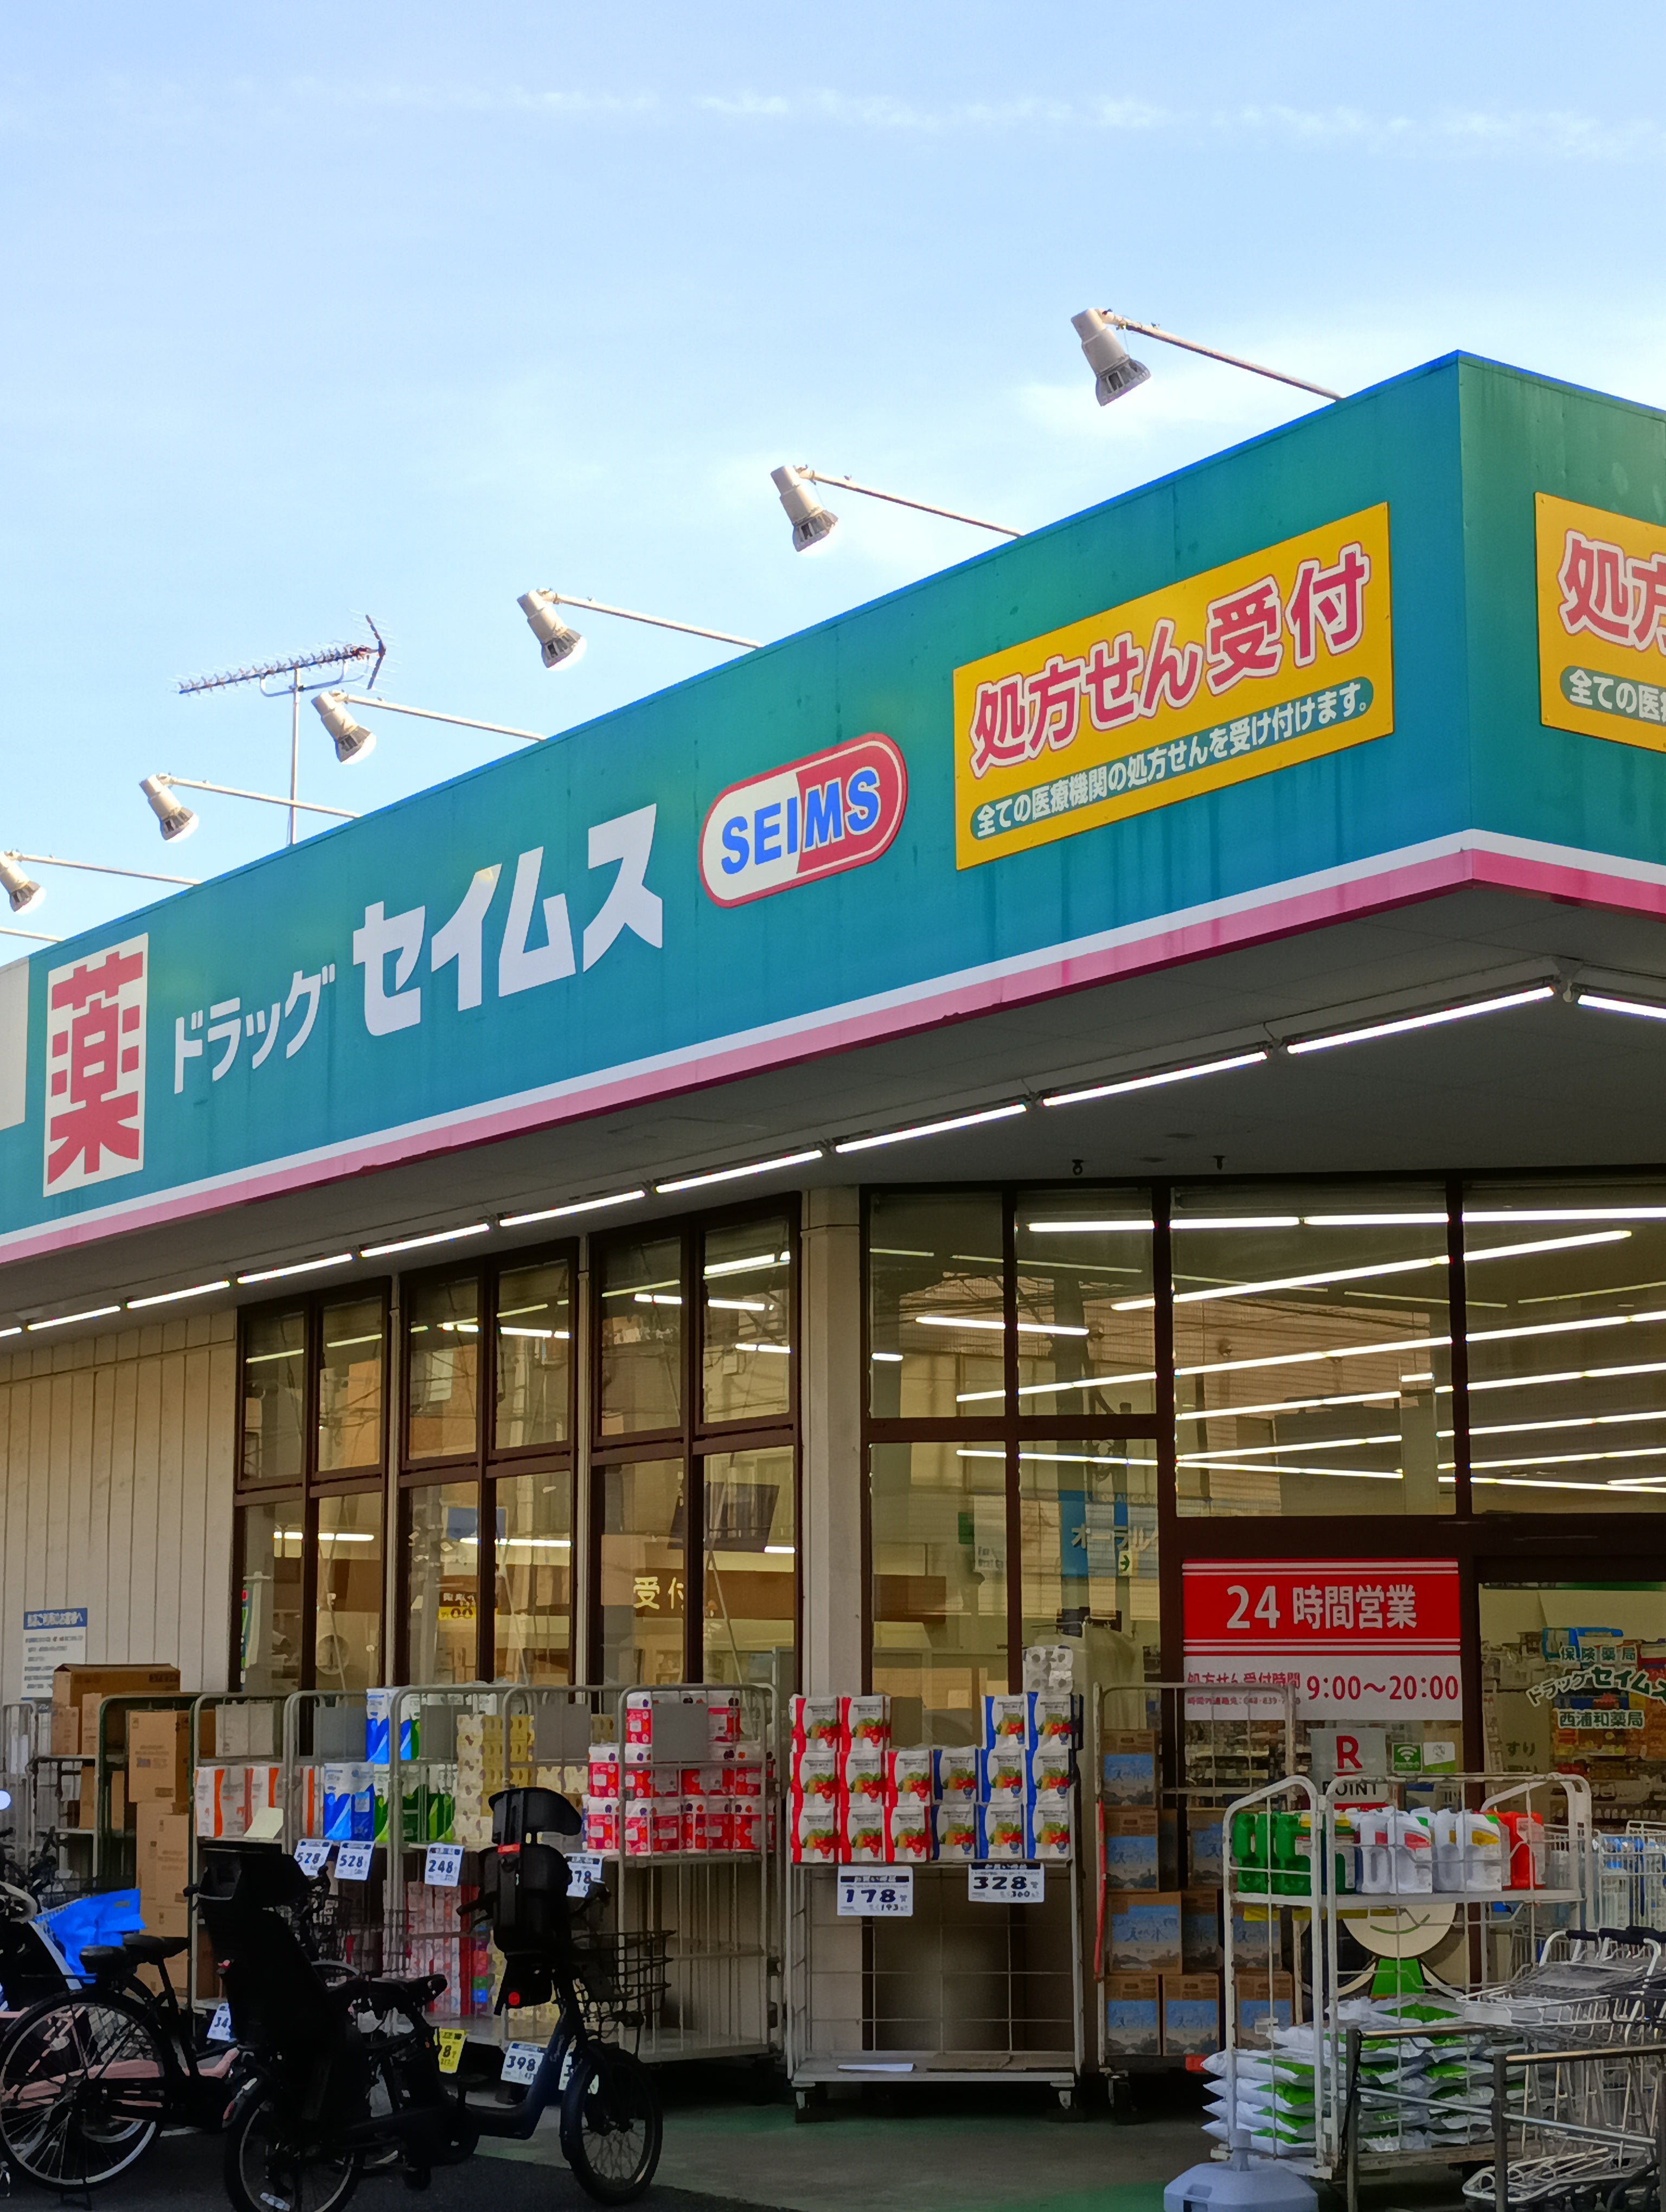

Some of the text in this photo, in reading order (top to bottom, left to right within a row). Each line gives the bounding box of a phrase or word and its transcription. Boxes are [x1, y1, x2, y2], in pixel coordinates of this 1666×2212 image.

[970, 542, 1370, 779] 処方せん受付
[1569, 670, 1666, 723] 全ての医
[977, 682, 1368, 838] 全ての医療機関の処方せんを受け付けます。
[721, 766, 882, 875] SEIMS
[48, 951, 144, 1185] 薬
[1226, 1584, 1417, 1630] 24 時間営業
[1561, 1647, 1636, 1661] 保険薬局
[1560, 1711, 1644, 1727] 西浦和薬局
[339, 1854, 364, 1868] 528
[428, 1859, 454, 1874] 248
[973, 1876, 1027, 1890] 328
[846, 1889, 896, 1903] 178
[506, 2055, 536, 2072] 398
